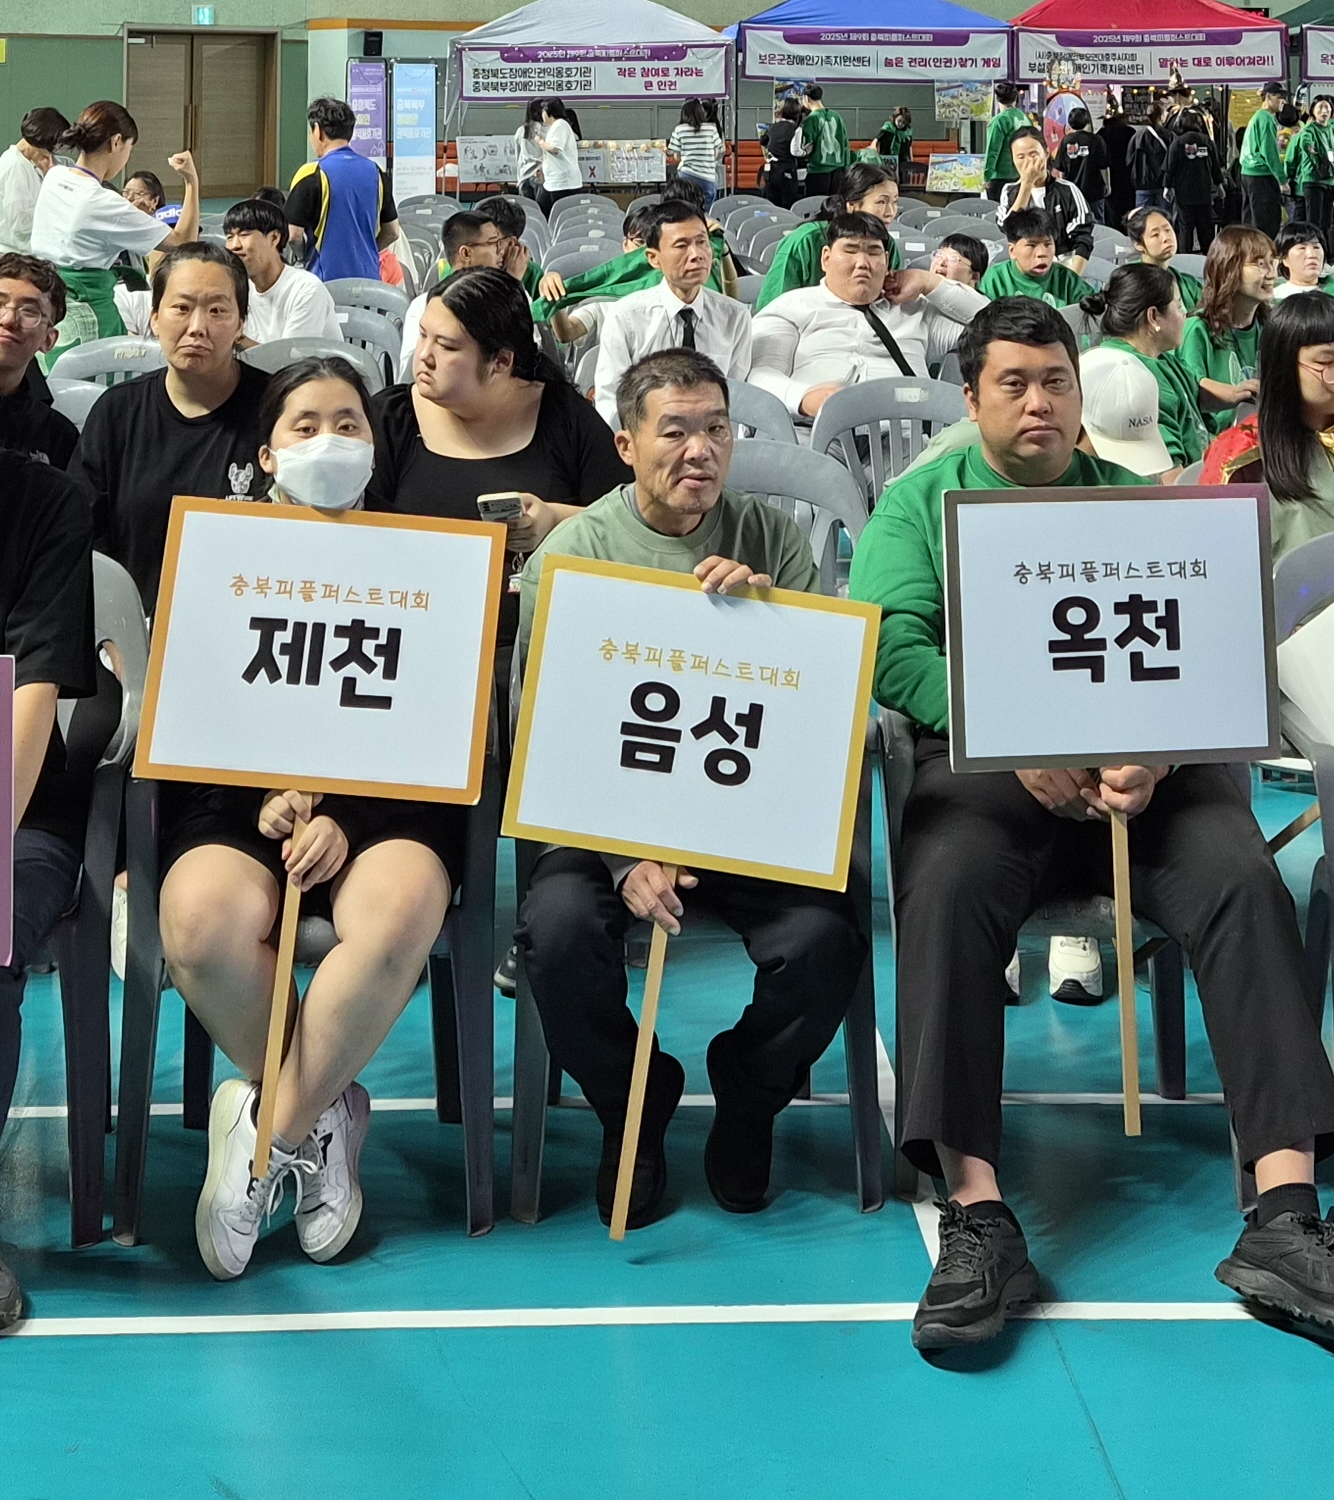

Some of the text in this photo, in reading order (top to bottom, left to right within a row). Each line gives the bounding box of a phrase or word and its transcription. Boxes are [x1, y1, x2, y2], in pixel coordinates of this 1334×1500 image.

[820, 32, 848, 41] 2025년
[1093, 35, 1121, 43] 2025년
[758, 53, 871, 68] 보은군장애인가족지원센터
[980, 57, 1001, 68] 게임
[1192, 57, 1212, 67] 대로
[472, 66, 592, 80] 충청북도장애인권익옹호기관
[673, 66, 703, 77] 자라는
[472, 80, 592, 93] 충북북부장애인권익옹호기관
[657, 80, 677, 91] 인권
[1013, 558, 1208, 585] 충북피플퍼스트대회
[229, 572, 431, 613] 충북피플퍼스트대회
[1048, 593, 1181, 683] 옥천
[241, 616, 403, 711] 제천
[597, 637, 803, 691] 충북피플퍼스트대회
[619, 680, 765, 787] 음성
